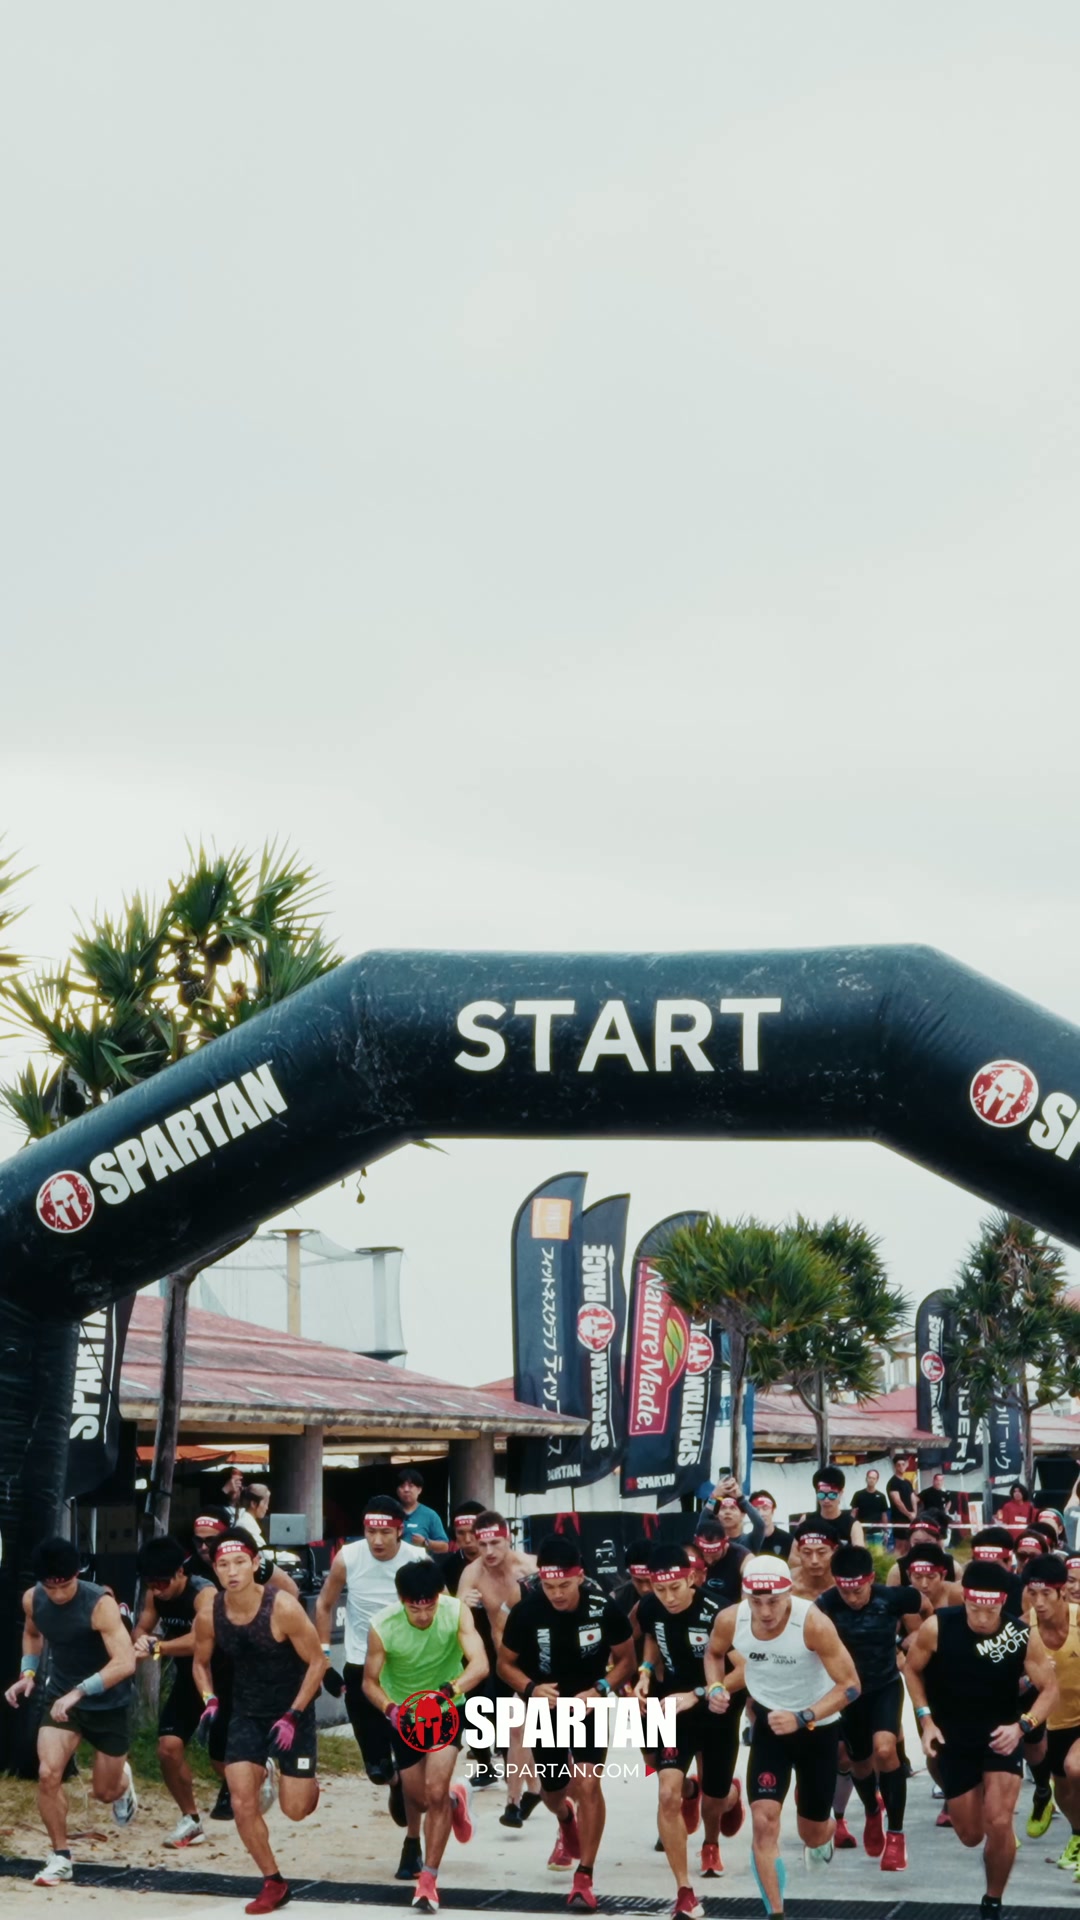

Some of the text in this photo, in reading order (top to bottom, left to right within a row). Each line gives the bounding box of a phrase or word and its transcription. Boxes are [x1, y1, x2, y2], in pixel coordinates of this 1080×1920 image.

[454, 997, 782, 1073] START
[89, 1064, 288, 1206] SPARTAN
[69, 1306, 108, 1440] SPARTA
[582, 1244, 609, 1451] SPARTAN RACE
[928, 1314, 942, 1353] RACE
[677, 1374, 705, 1467] SPARTAN
[547, 1464, 581, 1481] ARTAN
[989, 1627, 1030, 1664] SPORT
